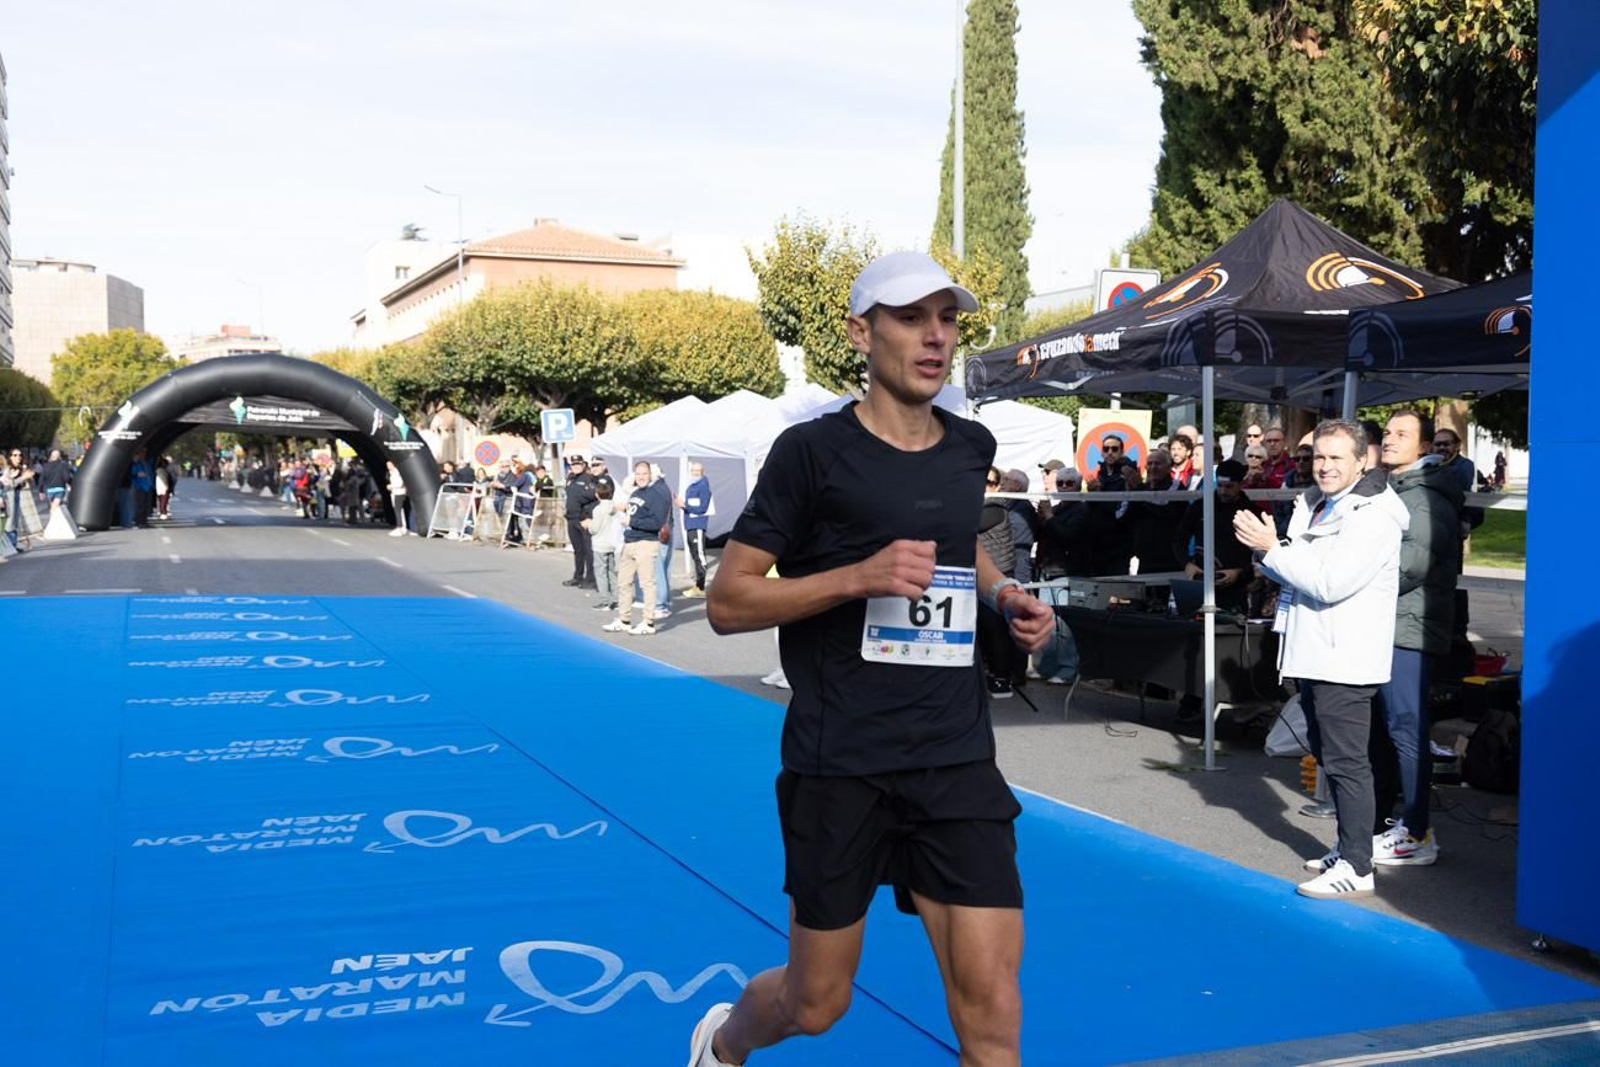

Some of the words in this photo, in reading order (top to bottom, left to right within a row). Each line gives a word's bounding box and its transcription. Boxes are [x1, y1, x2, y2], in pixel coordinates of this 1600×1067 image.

[549, 413, 568, 439] P
[909, 594, 953, 629] 61
[206, 836, 354, 853] MEDIA
[331, 947, 473, 974] JAÉN
[150, 969, 466, 1015] MARATÓN
[256, 992, 465, 1027] MEDIA
